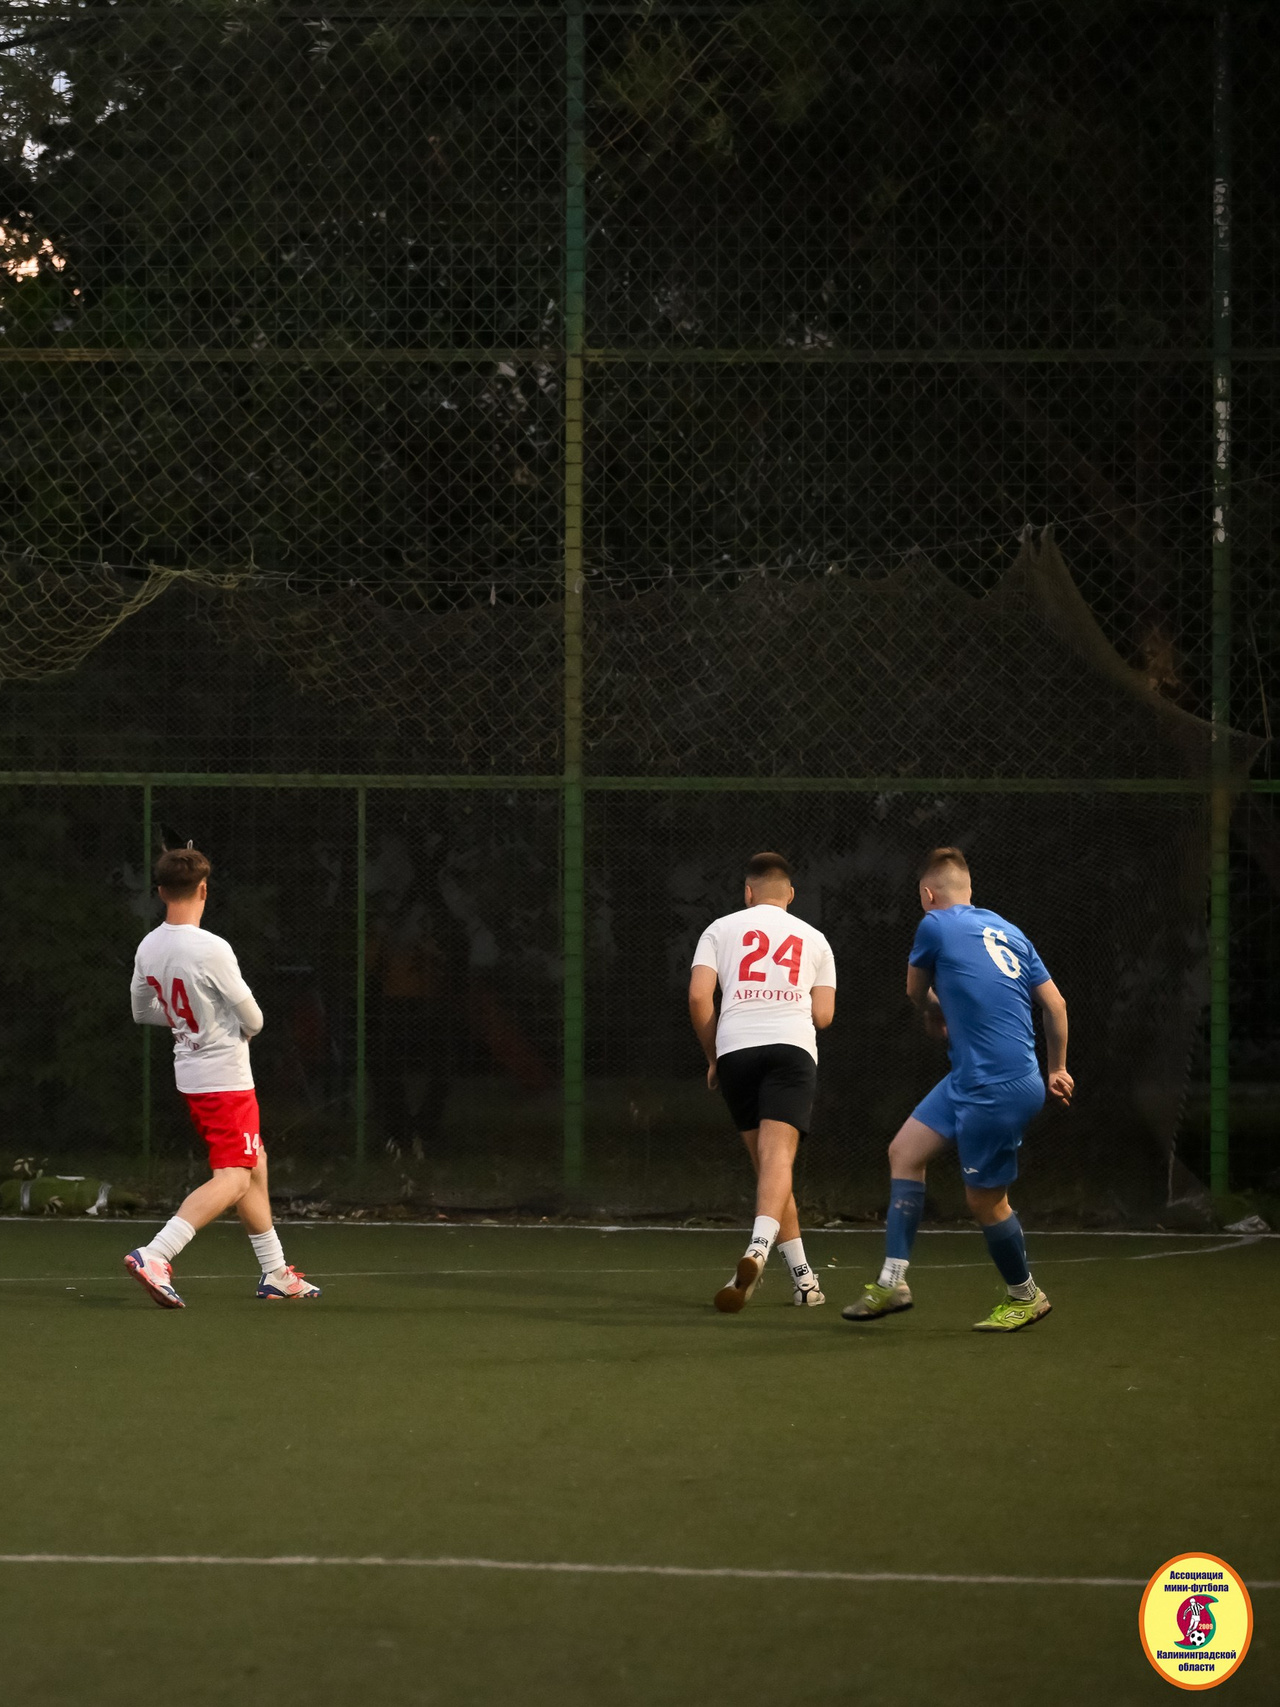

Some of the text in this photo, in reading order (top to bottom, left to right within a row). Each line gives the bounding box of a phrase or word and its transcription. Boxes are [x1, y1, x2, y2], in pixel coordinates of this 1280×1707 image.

[738, 929, 804, 986] 24
[982, 926, 1021, 979] 6
[732, 989, 803, 1003] АВТОТОР
[243, 1132, 260, 1156] 14
